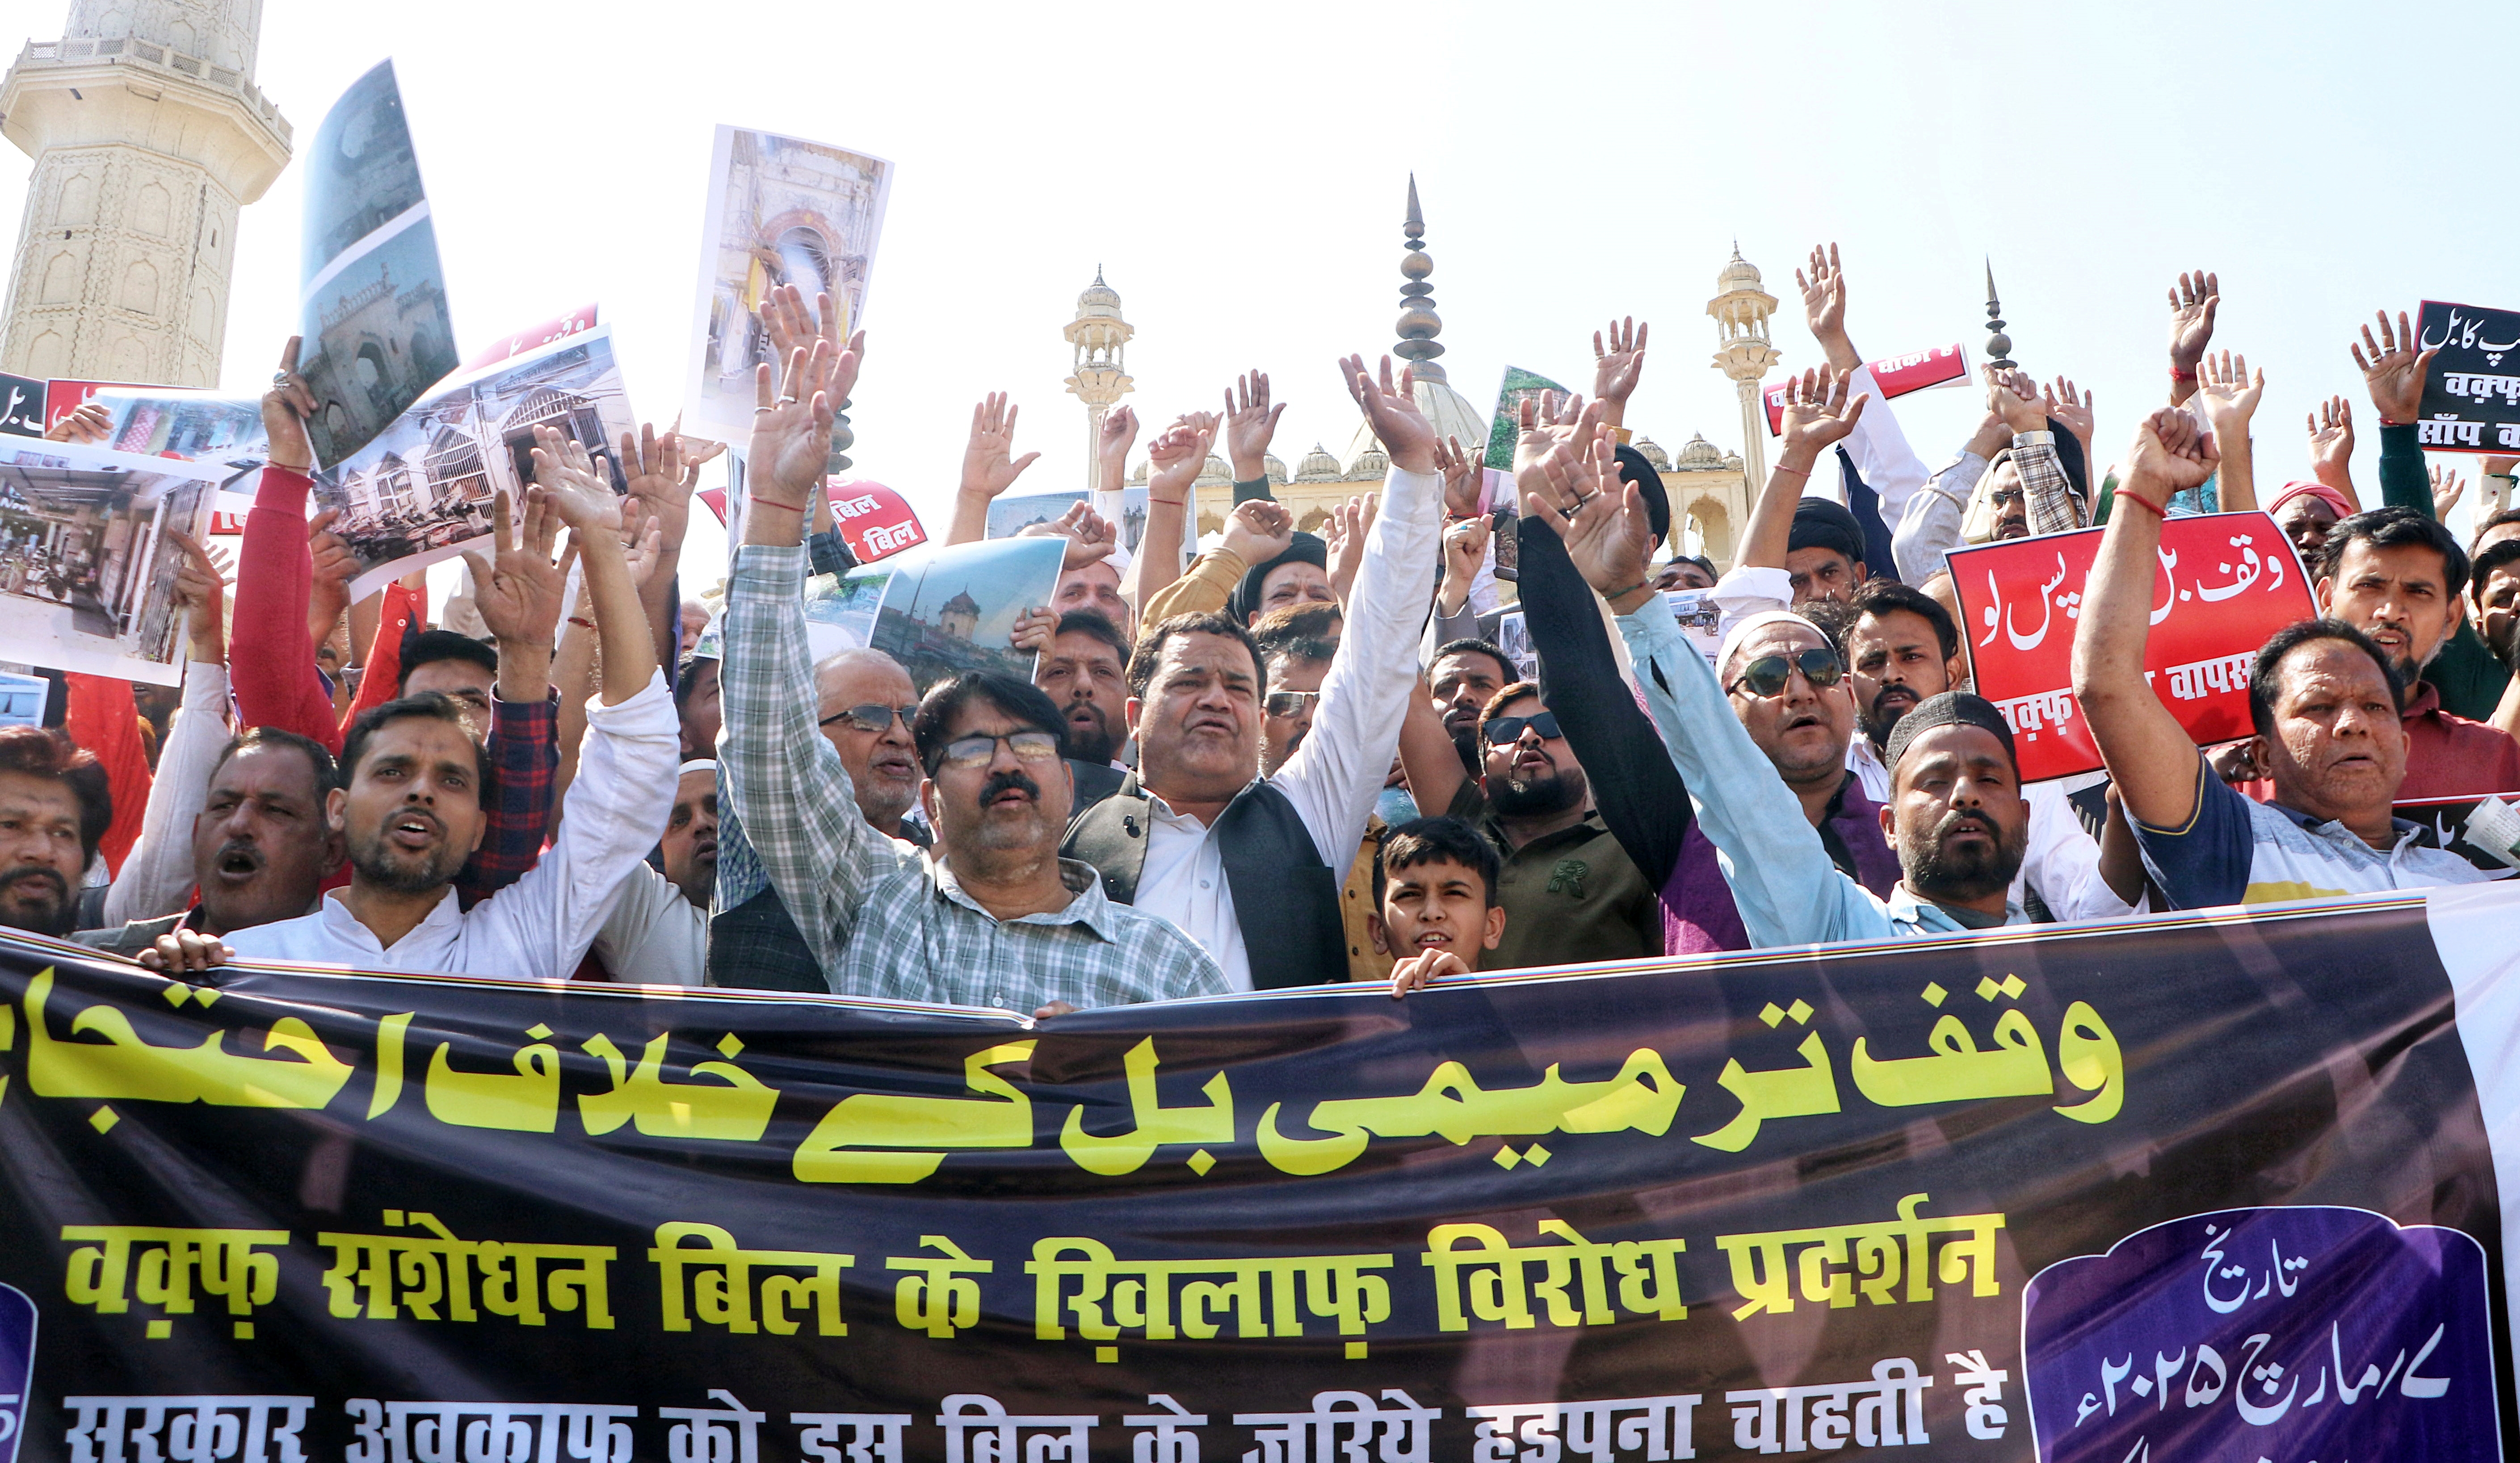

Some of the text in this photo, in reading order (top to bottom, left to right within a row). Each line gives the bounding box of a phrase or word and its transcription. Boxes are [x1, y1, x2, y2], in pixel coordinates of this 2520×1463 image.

[862, 519, 919, 557] बिल
[2196, 533, 2284, 602] وقف
[1979, 568, 2001, 647] لو
[424, 1022, 781, 1141] خلاف
[1852, 973, 2124, 1124] وقف
[792, 1039, 1039, 1184] کے
[1059, 1035, 1236, 1177] بل
[318, 1209, 617, 1329] संशोधन
[648, 1221, 855, 1337] बिल
[885, 1235, 993, 1338] के
[1421, 1219, 1688, 1332] विरोध
[1715, 1192, 2006, 1322] प्रदर्शन
[2201, 1223, 2308, 1314] تاریخ
[1725, 1357, 1934, 1455] चाहती
[1944, 1349, 2008, 1440] है
